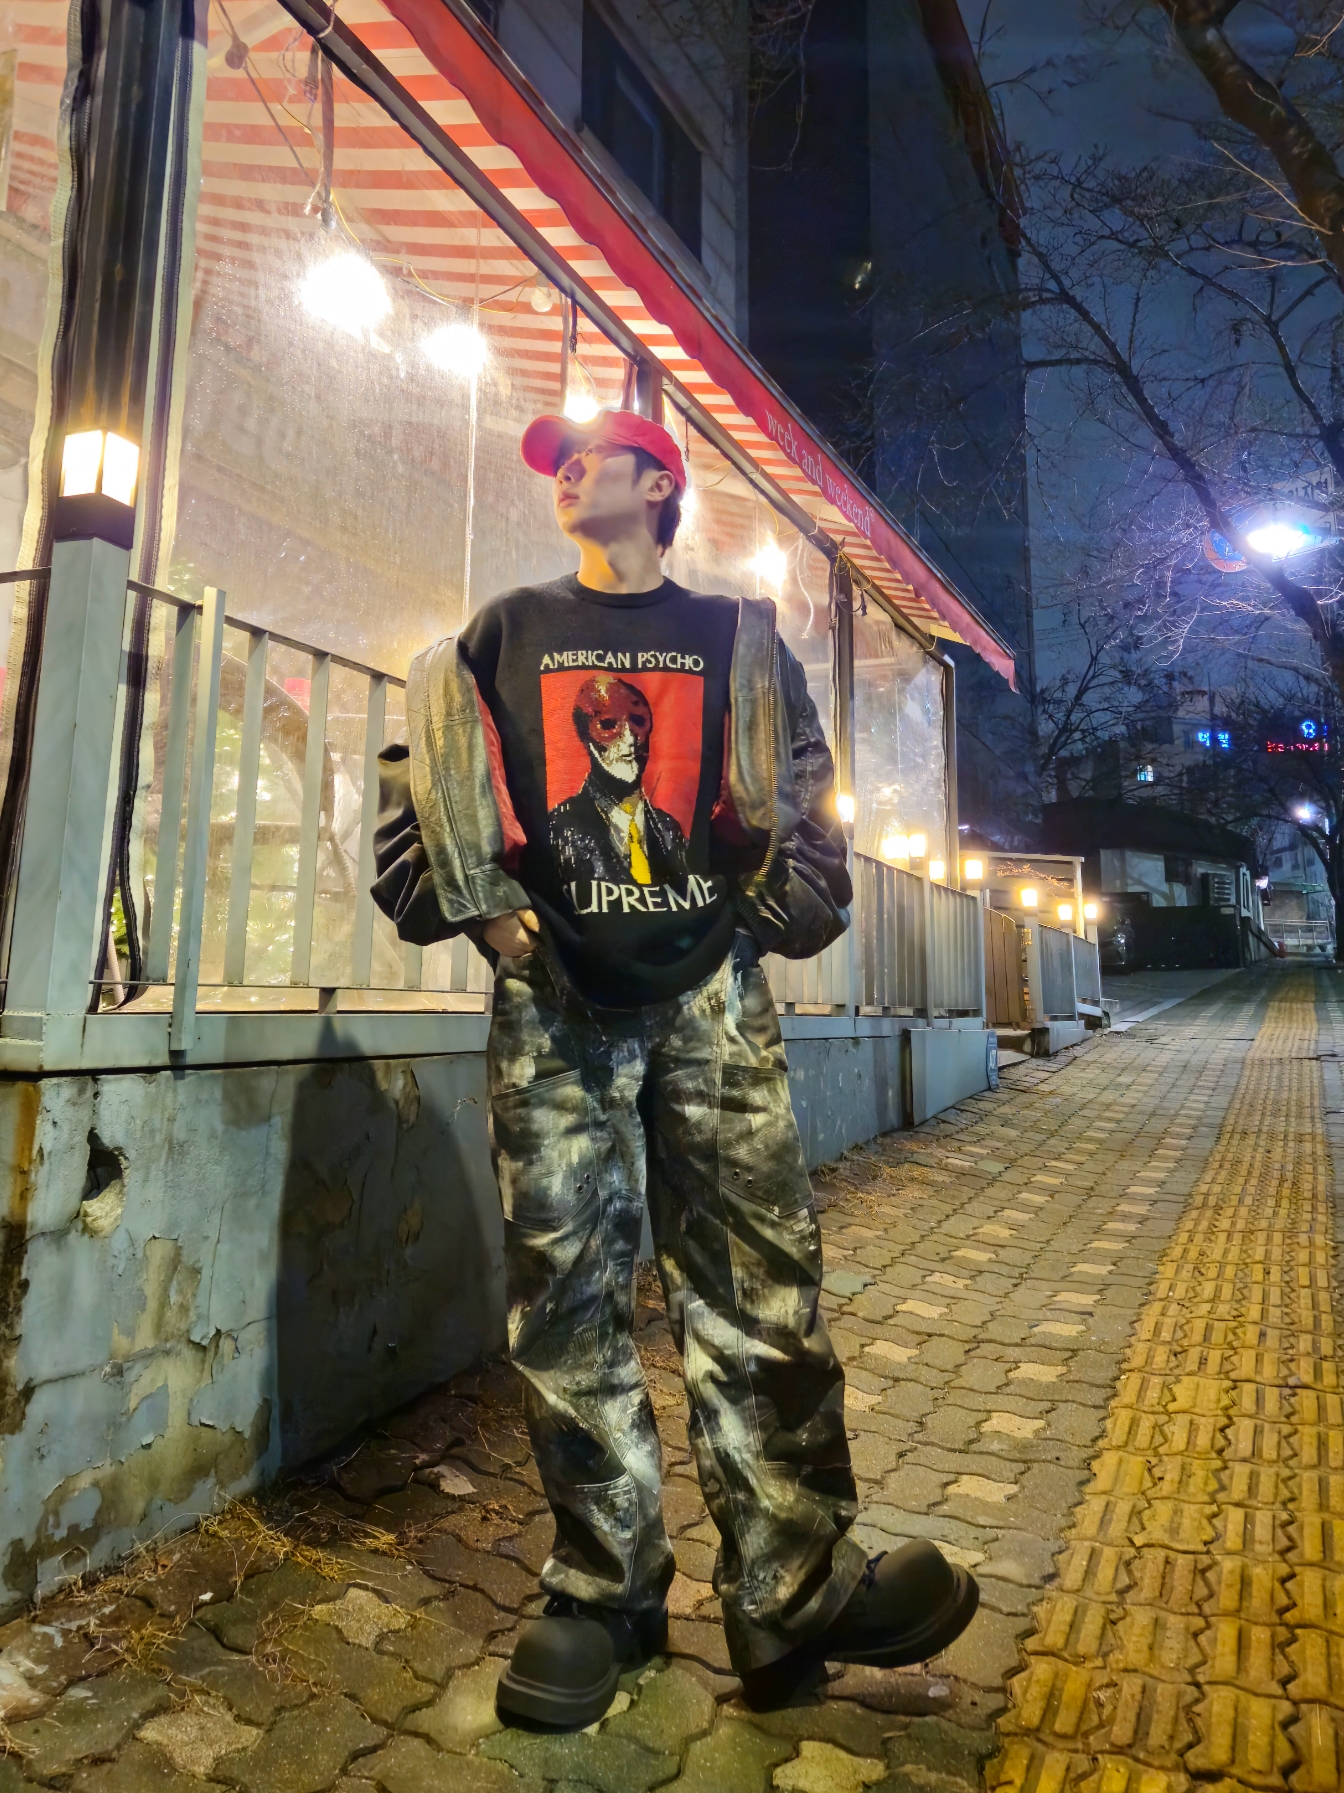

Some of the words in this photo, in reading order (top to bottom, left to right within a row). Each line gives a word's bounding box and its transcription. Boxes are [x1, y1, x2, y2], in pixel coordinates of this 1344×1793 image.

[765, 409, 799, 462] week
[801, 450, 824, 489] and
[825, 474, 872, 538] weekend
[540, 650, 630, 671] AMERICAN
[637, 651, 704, 672] PSYCHO
